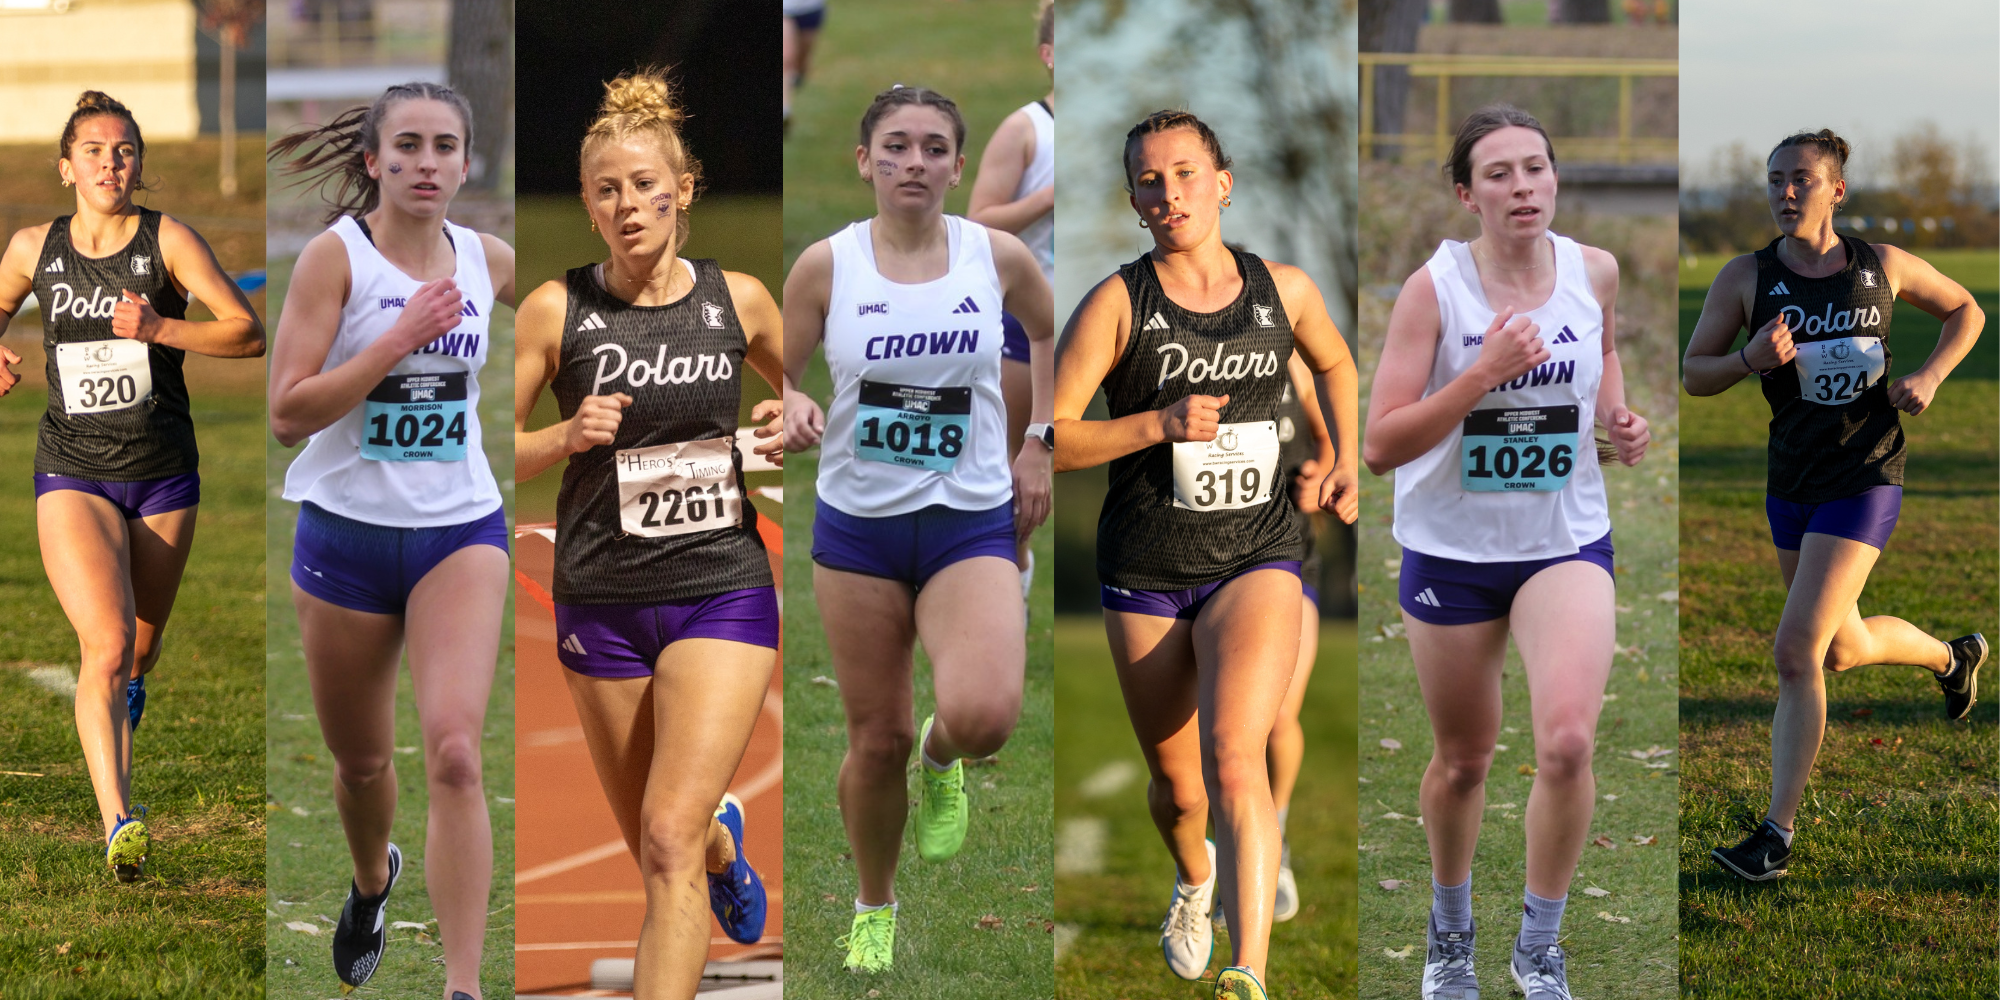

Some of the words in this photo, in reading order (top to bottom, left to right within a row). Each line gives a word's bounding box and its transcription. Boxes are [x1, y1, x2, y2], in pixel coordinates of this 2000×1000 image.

[51, 283, 150, 322] Pola
[859, 303, 888, 316] UMAC
[1780, 302, 1880, 336] Polars
[865, 329, 979, 361] CROWN
[1463, 336, 1485, 347] UMA
[592, 343, 733, 396] Polars
[1157, 342, 1278, 391] Polars
[79, 374, 136, 408] 320
[412, 389, 434, 400] UMAC
[1814, 370, 1869, 402] 324
[401, 403, 443, 412] MORRISON
[897, 412, 931, 421] ARROYO
[904, 400, 929, 411] UMAC
[368, 411, 467, 447] 1024
[860, 416, 964, 458] 1018
[1503, 436, 1539, 444] STANLEY
[1510, 423, 1534, 433] UMAC
[894, 456, 925, 466] CROWN
[1468, 444, 1573, 479] 1026
[1194, 467, 1261, 507] 319
[639, 483, 725, 528] 2261
